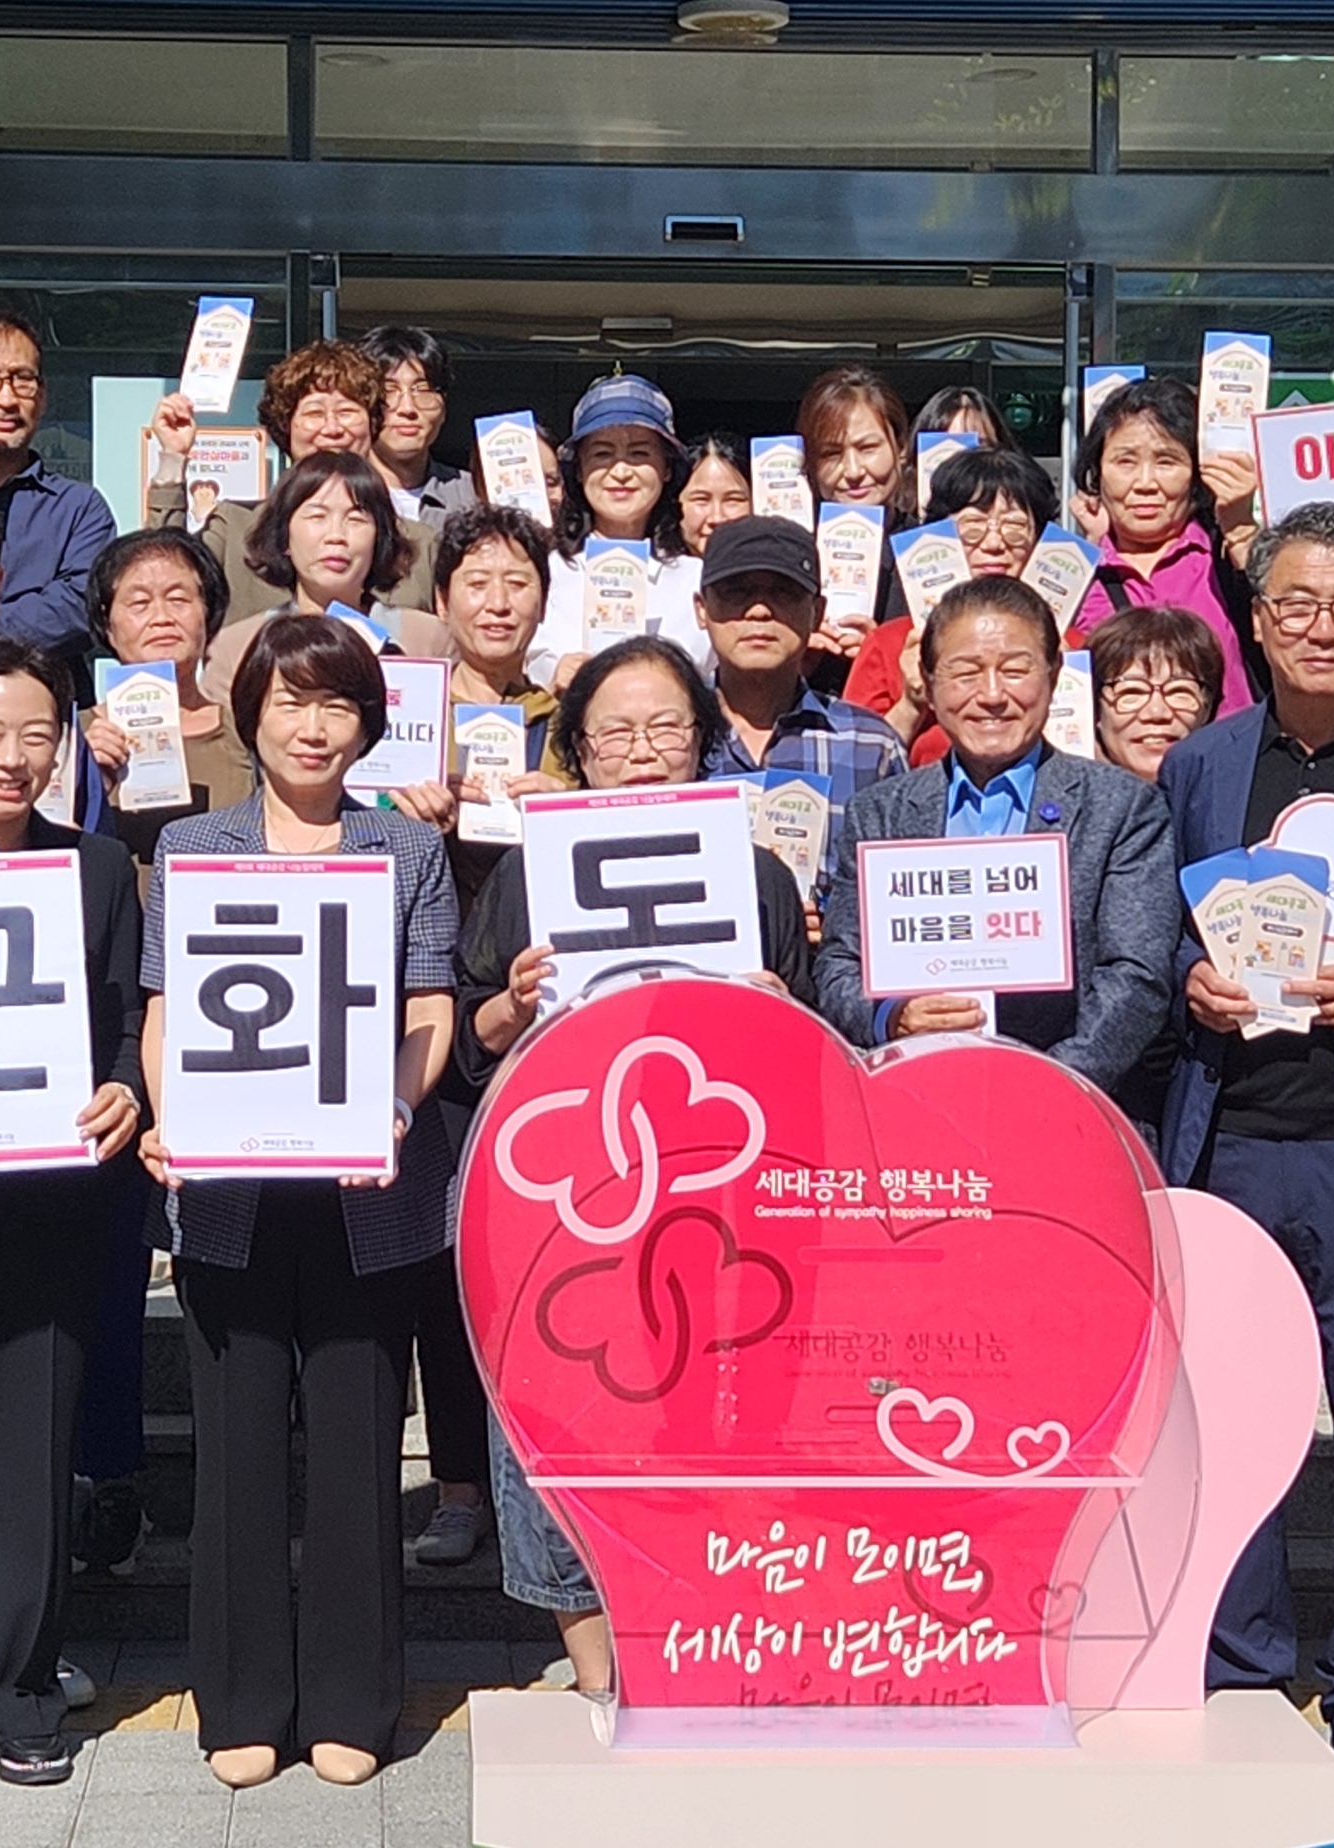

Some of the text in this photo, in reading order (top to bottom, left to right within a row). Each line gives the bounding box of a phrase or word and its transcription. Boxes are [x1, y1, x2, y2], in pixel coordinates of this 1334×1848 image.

[888, 864, 1039, 898] 세대를 넘어
[890, 910, 1043, 943] 마음을 잇다
[182, 902, 377, 1105] 화
[754, 1168, 993, 1202] 세대공감 행복나눔
[754, 1204, 993, 1221] Generation of sympathy happiness sharing
[706, 1520, 828, 1593] 마음이
[662, 1605, 1018, 1678] 세상이 변합니다
